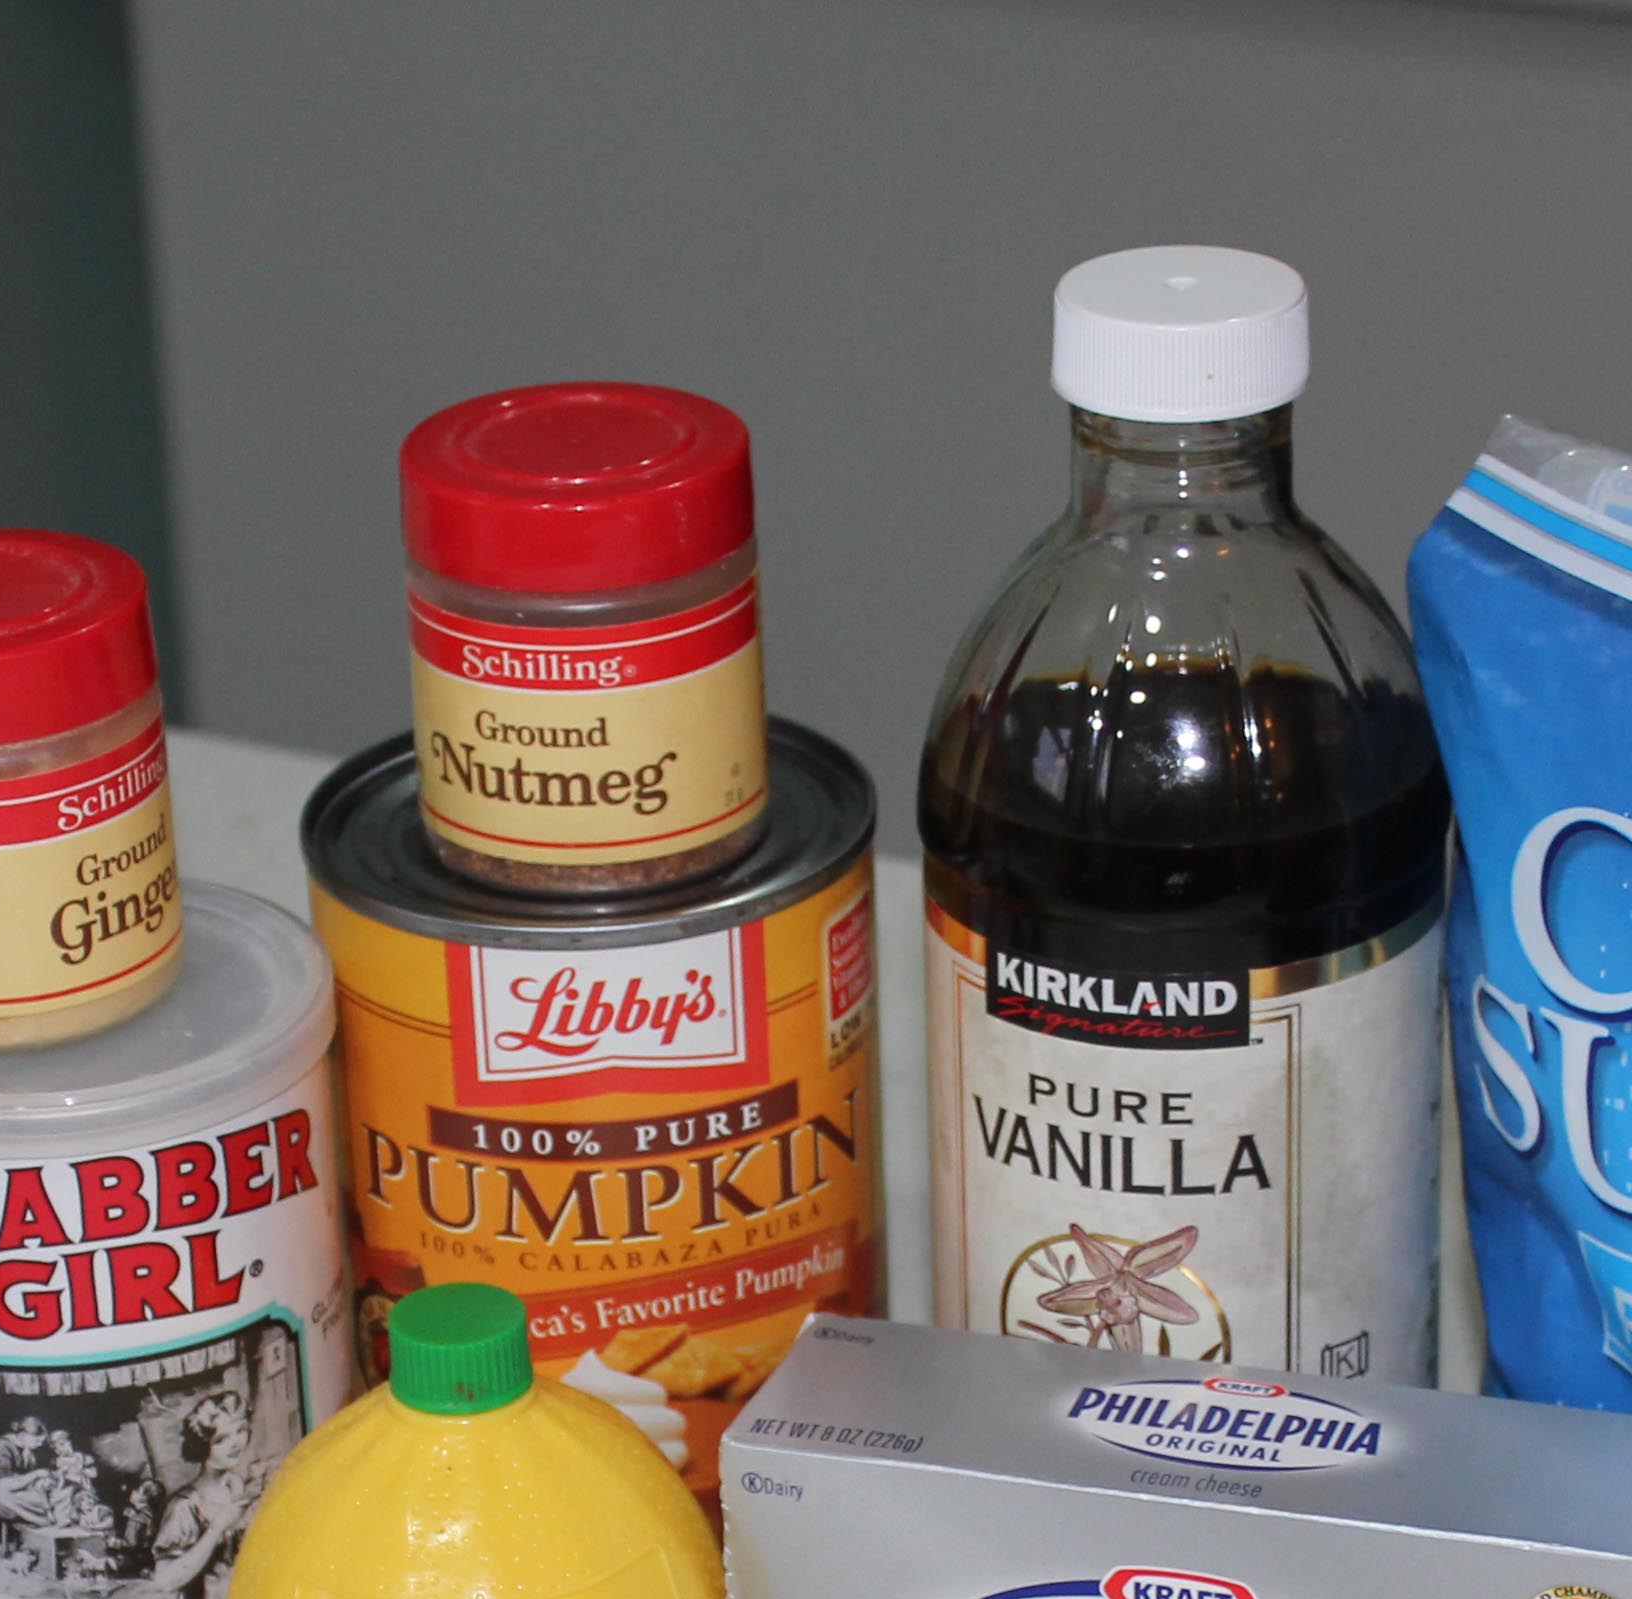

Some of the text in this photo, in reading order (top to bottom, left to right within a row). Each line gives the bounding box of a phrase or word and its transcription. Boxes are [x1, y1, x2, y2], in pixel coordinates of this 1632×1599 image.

[461, 645, 623, 687] Schilling
[474, 711, 610, 749] Ground
[430, 731, 678, 816] Nutmeg
[76, 812, 168, 886] Ground
[50, 861, 178, 966] Ginge
[494, 965, 717, 1056] Libby's
[996, 951, 1239, 1019] KIRKLAND
[997, 996, 1239, 1039] Signature
[471, 1099, 763, 1156] 100% PURE
[1027, 1073, 1195, 1126] PURE
[361, 1087, 862, 1247] PUMPKIN
[972, 1094, 1273, 1196] VANILLA
[419, 1201, 824, 1273] 100% CALABAZA PURA
[597, 1280, 726, 1330] Favorite
[734, 1244, 847, 1301] Pumpkin
[1067, 1386, 1383, 1456] PHILADELPHIA
[1217, 1380, 1274, 1396] KRAFT
[750, 1417, 925, 1455] NET WT 8 OZ (226g)
[1144, 1432, 1282, 1463] ORIGINAL
[1130, 1467, 1263, 1500] cream cheese
